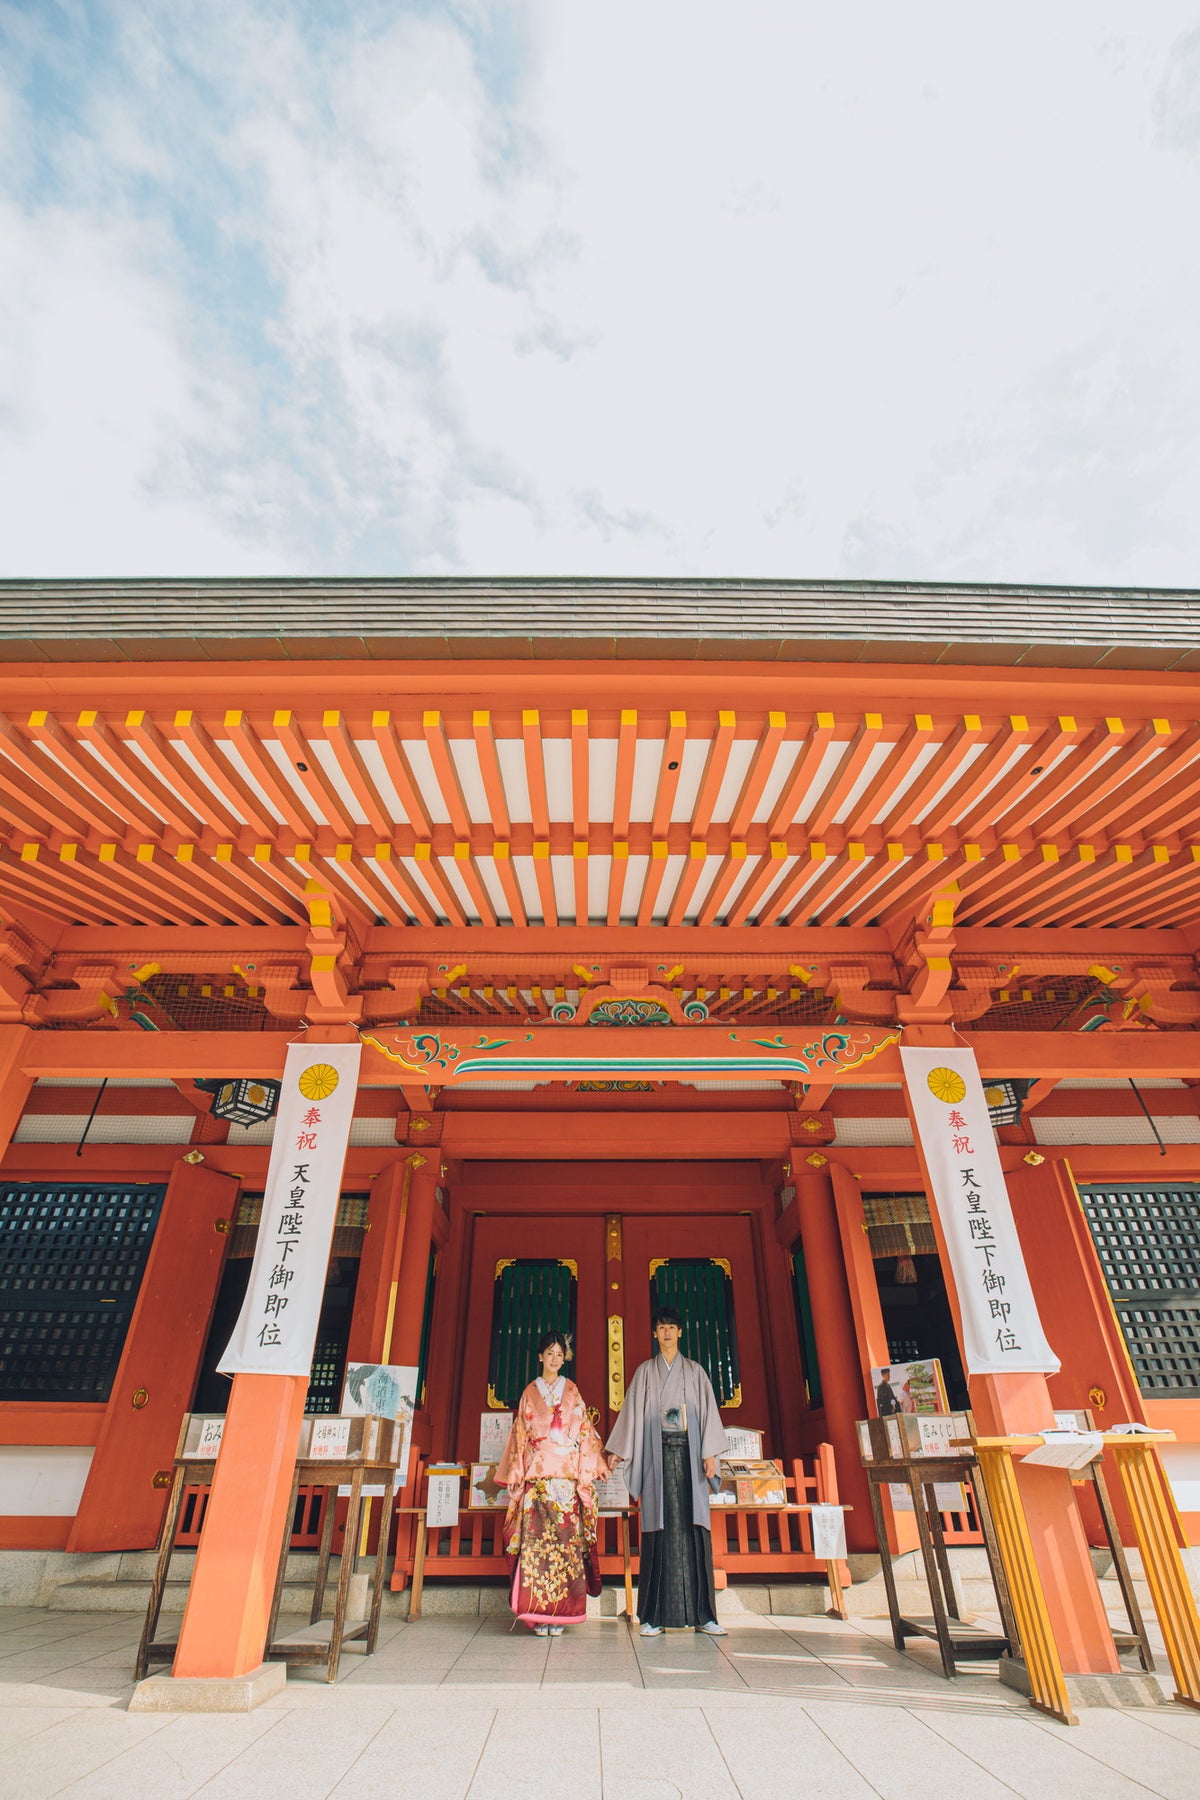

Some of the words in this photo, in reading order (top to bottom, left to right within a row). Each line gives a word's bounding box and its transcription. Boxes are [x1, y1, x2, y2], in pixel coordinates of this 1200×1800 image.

[296, 1107, 322, 1151] 奉祝
[947, 1110, 975, 1155] 奉祝
[256, 1163, 312, 1348] 天皇陛下御即位
[959, 1167, 1022, 1353] 天皇陛下御即位
